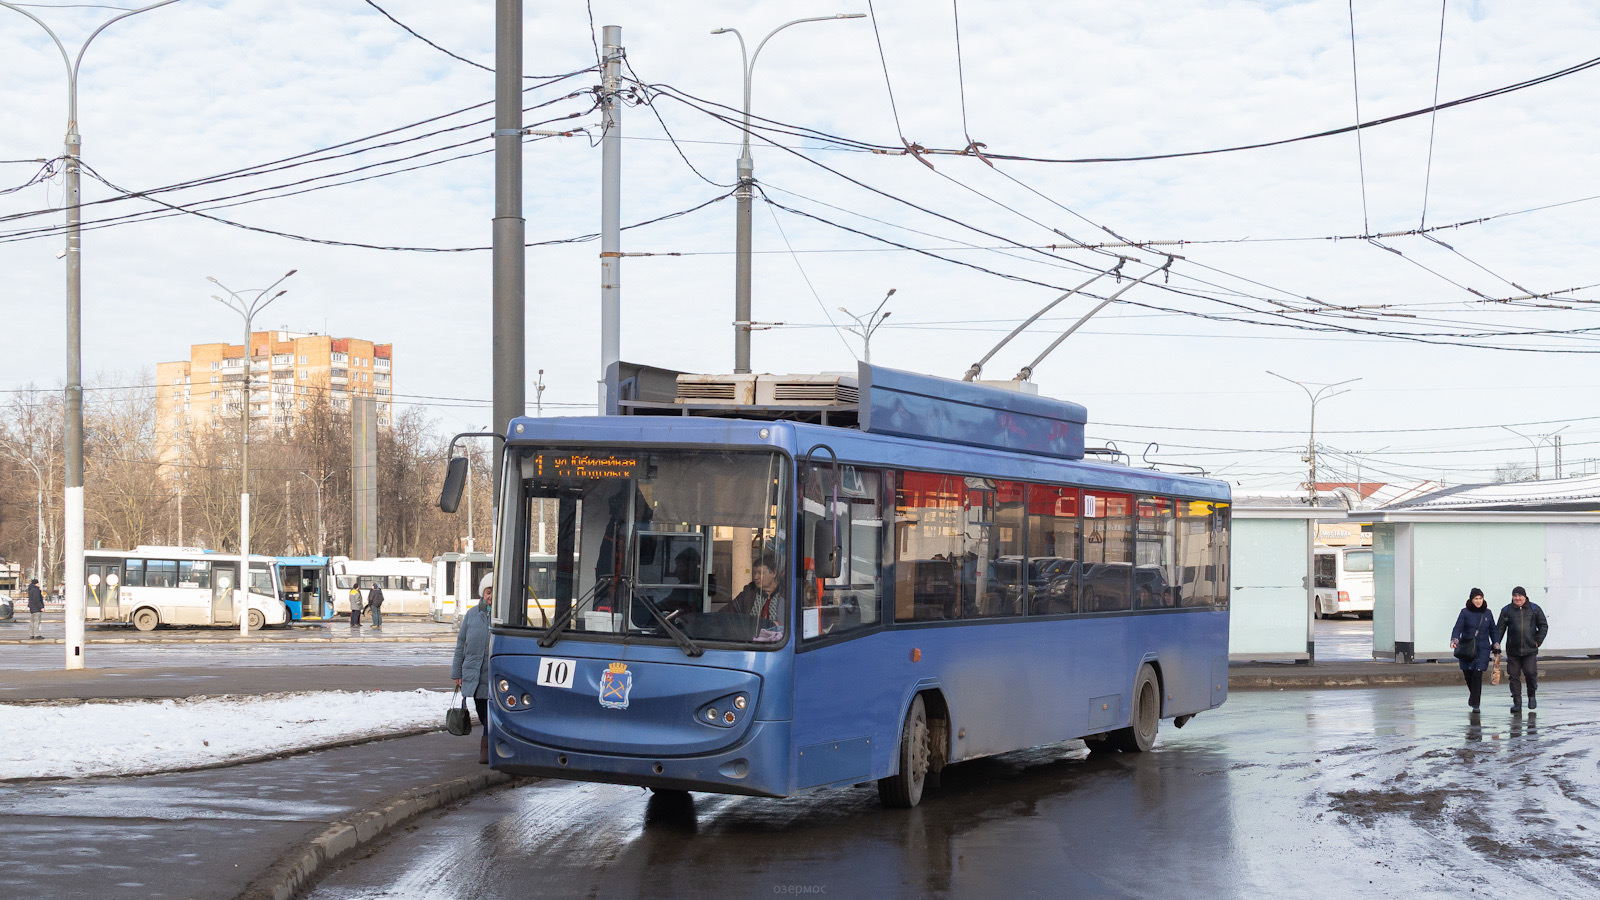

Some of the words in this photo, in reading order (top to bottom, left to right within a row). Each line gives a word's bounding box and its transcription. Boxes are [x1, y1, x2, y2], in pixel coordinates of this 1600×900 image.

[535, 455, 543, 476] 1
[555, 459, 567, 468] ул
[571, 455, 636, 467] Юбилейная
[1086, 497, 1094, 515] 10
[543, 661, 568, 685] 10
